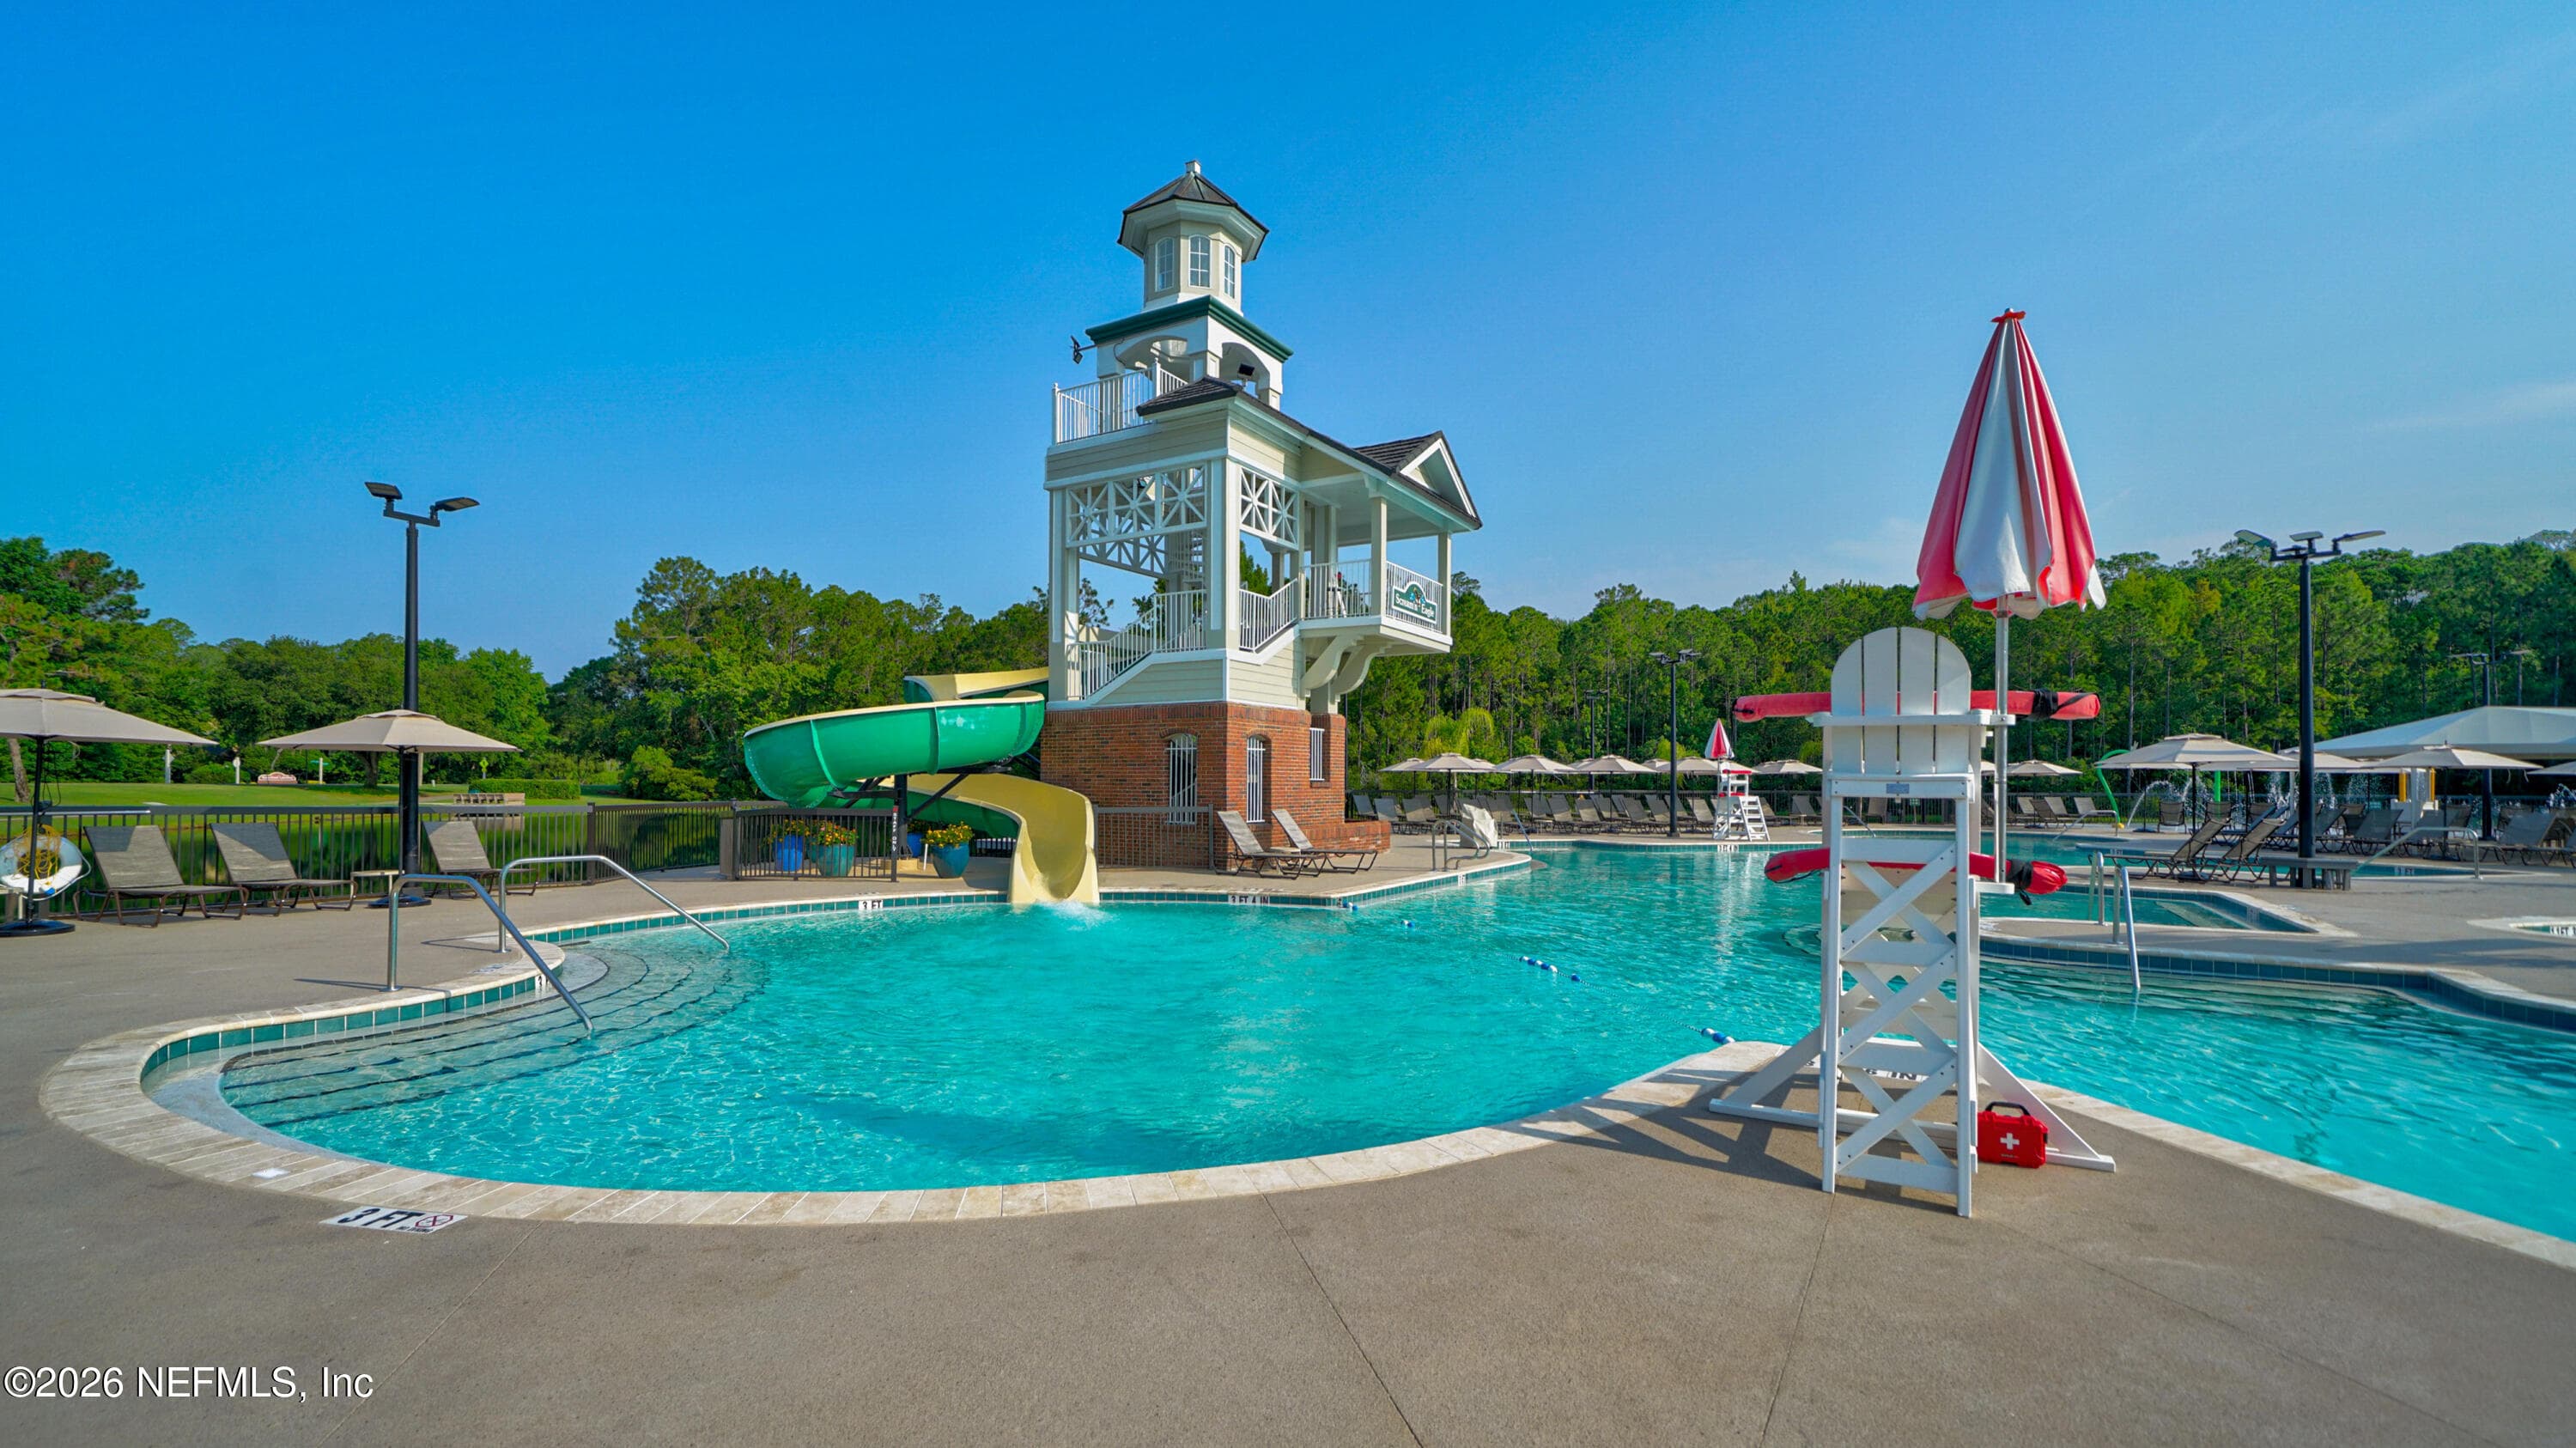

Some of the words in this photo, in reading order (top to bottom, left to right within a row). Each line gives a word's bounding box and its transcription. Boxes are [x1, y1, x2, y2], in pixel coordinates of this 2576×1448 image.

[1238, 895, 1249, 903] FT
[1260, 895, 1269, 904] IN
[871, 900, 882, 910] FT
[337, 1208, 380, 1224] 3
[361, 1210, 426, 1228] FT
